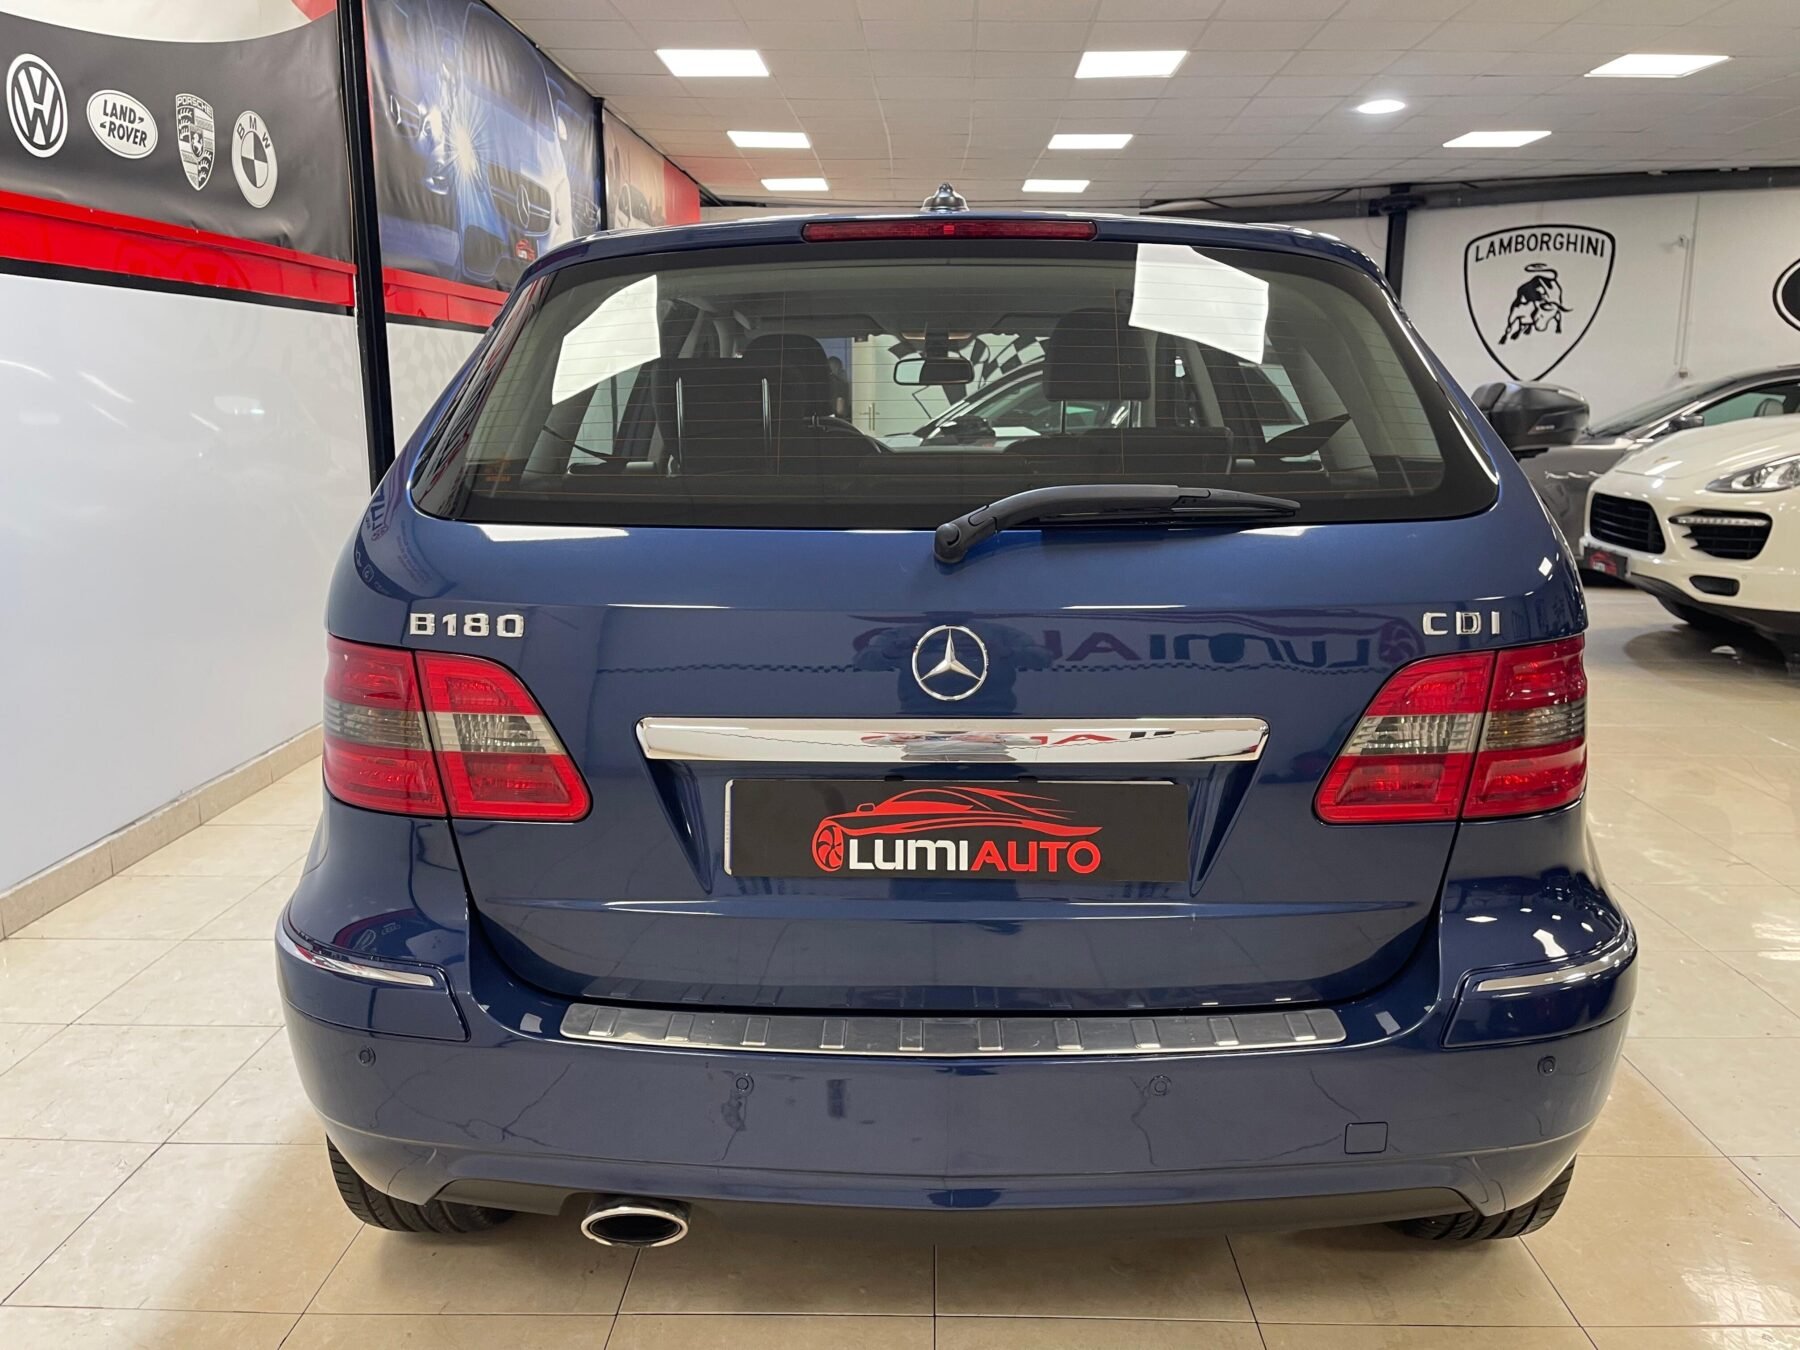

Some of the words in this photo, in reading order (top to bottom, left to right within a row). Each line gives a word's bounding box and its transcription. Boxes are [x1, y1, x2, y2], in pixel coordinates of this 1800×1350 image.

[102, 98, 137, 125] LAND
[177, 95, 213, 118] PORSCHE
[107, 124, 148, 149] ROVER
[236, 114, 271, 150] BMW
[1475, 233, 1606, 262] LAMBORGHINI
[409, 612, 525, 638] B180
[1422, 610, 1502, 636] CDI
